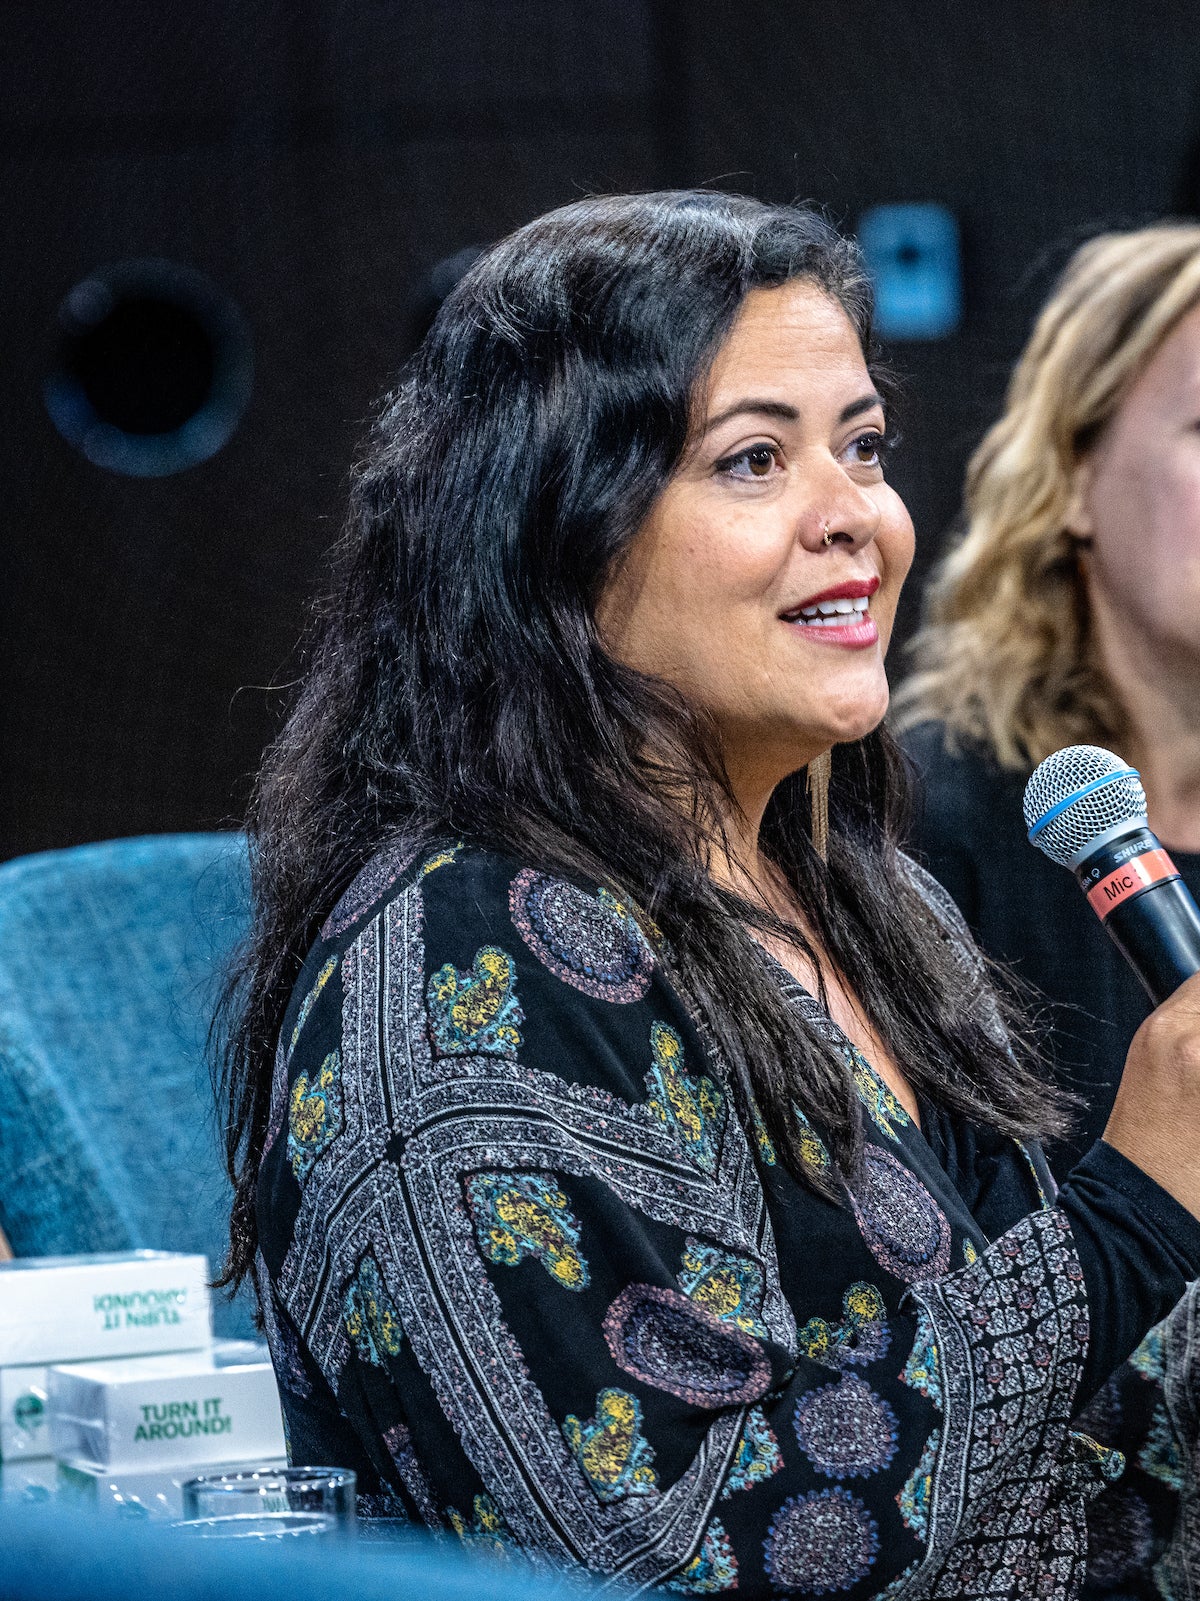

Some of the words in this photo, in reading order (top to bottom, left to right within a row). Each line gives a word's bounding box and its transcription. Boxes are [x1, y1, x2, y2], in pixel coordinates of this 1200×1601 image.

[1113, 839, 1154, 863] SHURE
[1103, 876, 1134, 901] Mic
[140, 1401, 198, 1422] TURN
[203, 1397, 222, 1417] IT
[134, 1415, 232, 1443] AROUND!
